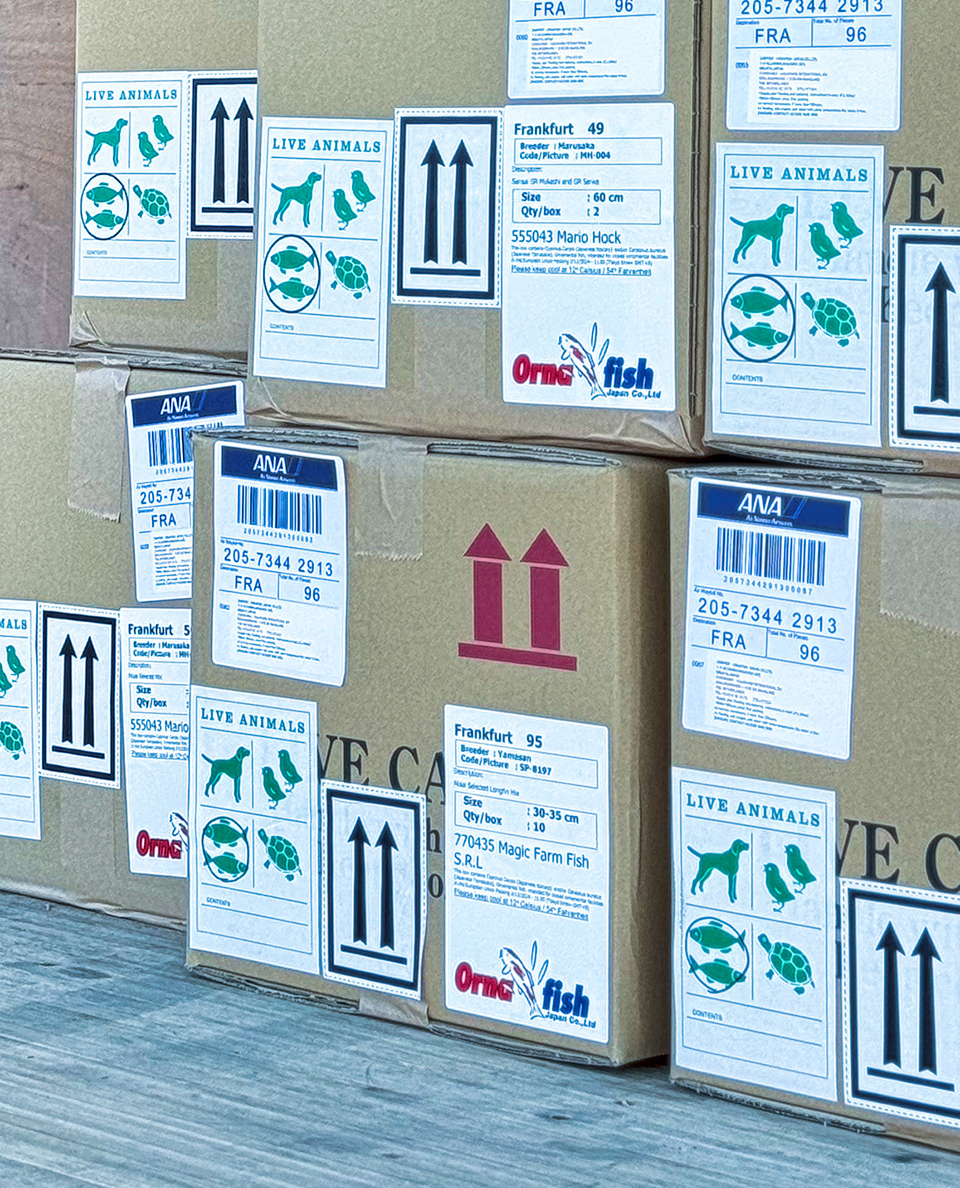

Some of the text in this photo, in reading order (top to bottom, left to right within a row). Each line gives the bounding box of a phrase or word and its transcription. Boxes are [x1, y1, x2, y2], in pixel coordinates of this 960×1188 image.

[533, 1, 566, 17] FRA
[754, 27, 791, 44] FRA
[846, 26, 867, 43] 96
[85, 89, 178, 101] LIVE ANIMALS
[514, 121, 605, 135] Frankfurt 49
[272, 138, 381, 153] LIVE ANIMALS
[520, 142, 550, 150] Breeder
[558, 142, 595, 150] Marusaka
[520, 151, 570, 160] Code/Picture
[580, 152, 611, 160] MH-004
[730, 166, 869, 182] LIVE ANIMALS
[521, 192, 542, 202] Size
[593, 192, 606, 203] 60
[608, 194, 624, 203] cm
[521, 206, 561, 218] Qty/box
[593, 206, 600, 217] 2
[512, 230, 622, 244] 555043 Mario Hock
[603, 356, 654, 390] fish
[606, 389, 629, 398] Japan
[160, 394, 191, 415] ANA
[252, 454, 287, 475] ANA
[737, 492, 782, 516] ANA
[151, 512, 176, 528] FRA
[224, 547, 333, 576] 205-7344 2913
[234, 575, 263, 593] FRA
[304, 586, 320, 602] 96
[698, 598, 837, 634] 205-7344 2913
[128, 623, 174, 636] Frankfurt
[711, 629, 746, 650] FRA
[800, 644, 820, 662] 96
[136, 685, 152, 694] Size
[136, 697, 167, 708] Qty/box
[130, 718, 189, 733] 555043 Mario
[200, 707, 306, 734] LIVE ANIMALS
[454, 724, 543, 748] Frankfurt 95
[460, 744, 490, 756] Breeder
[460, 754, 510, 769] Code/Picture
[520, 763, 552, 776] SP-8197
[463, 795, 483, 808] Size
[533, 806, 562, 820] 30-35
[564, 813, 580, 824] cm
[686, 793, 820, 827] LIVE ANIMALS
[463, 810, 502, 826] Qty/box
[533, 822, 546, 832] 10
[454, 832, 590, 869] 770435 Magic Farm Fish
[454, 852, 483, 870] S.R.L
[542, 978, 590, 1018] fish
[692, 1008, 723, 1021] CONTENTS
